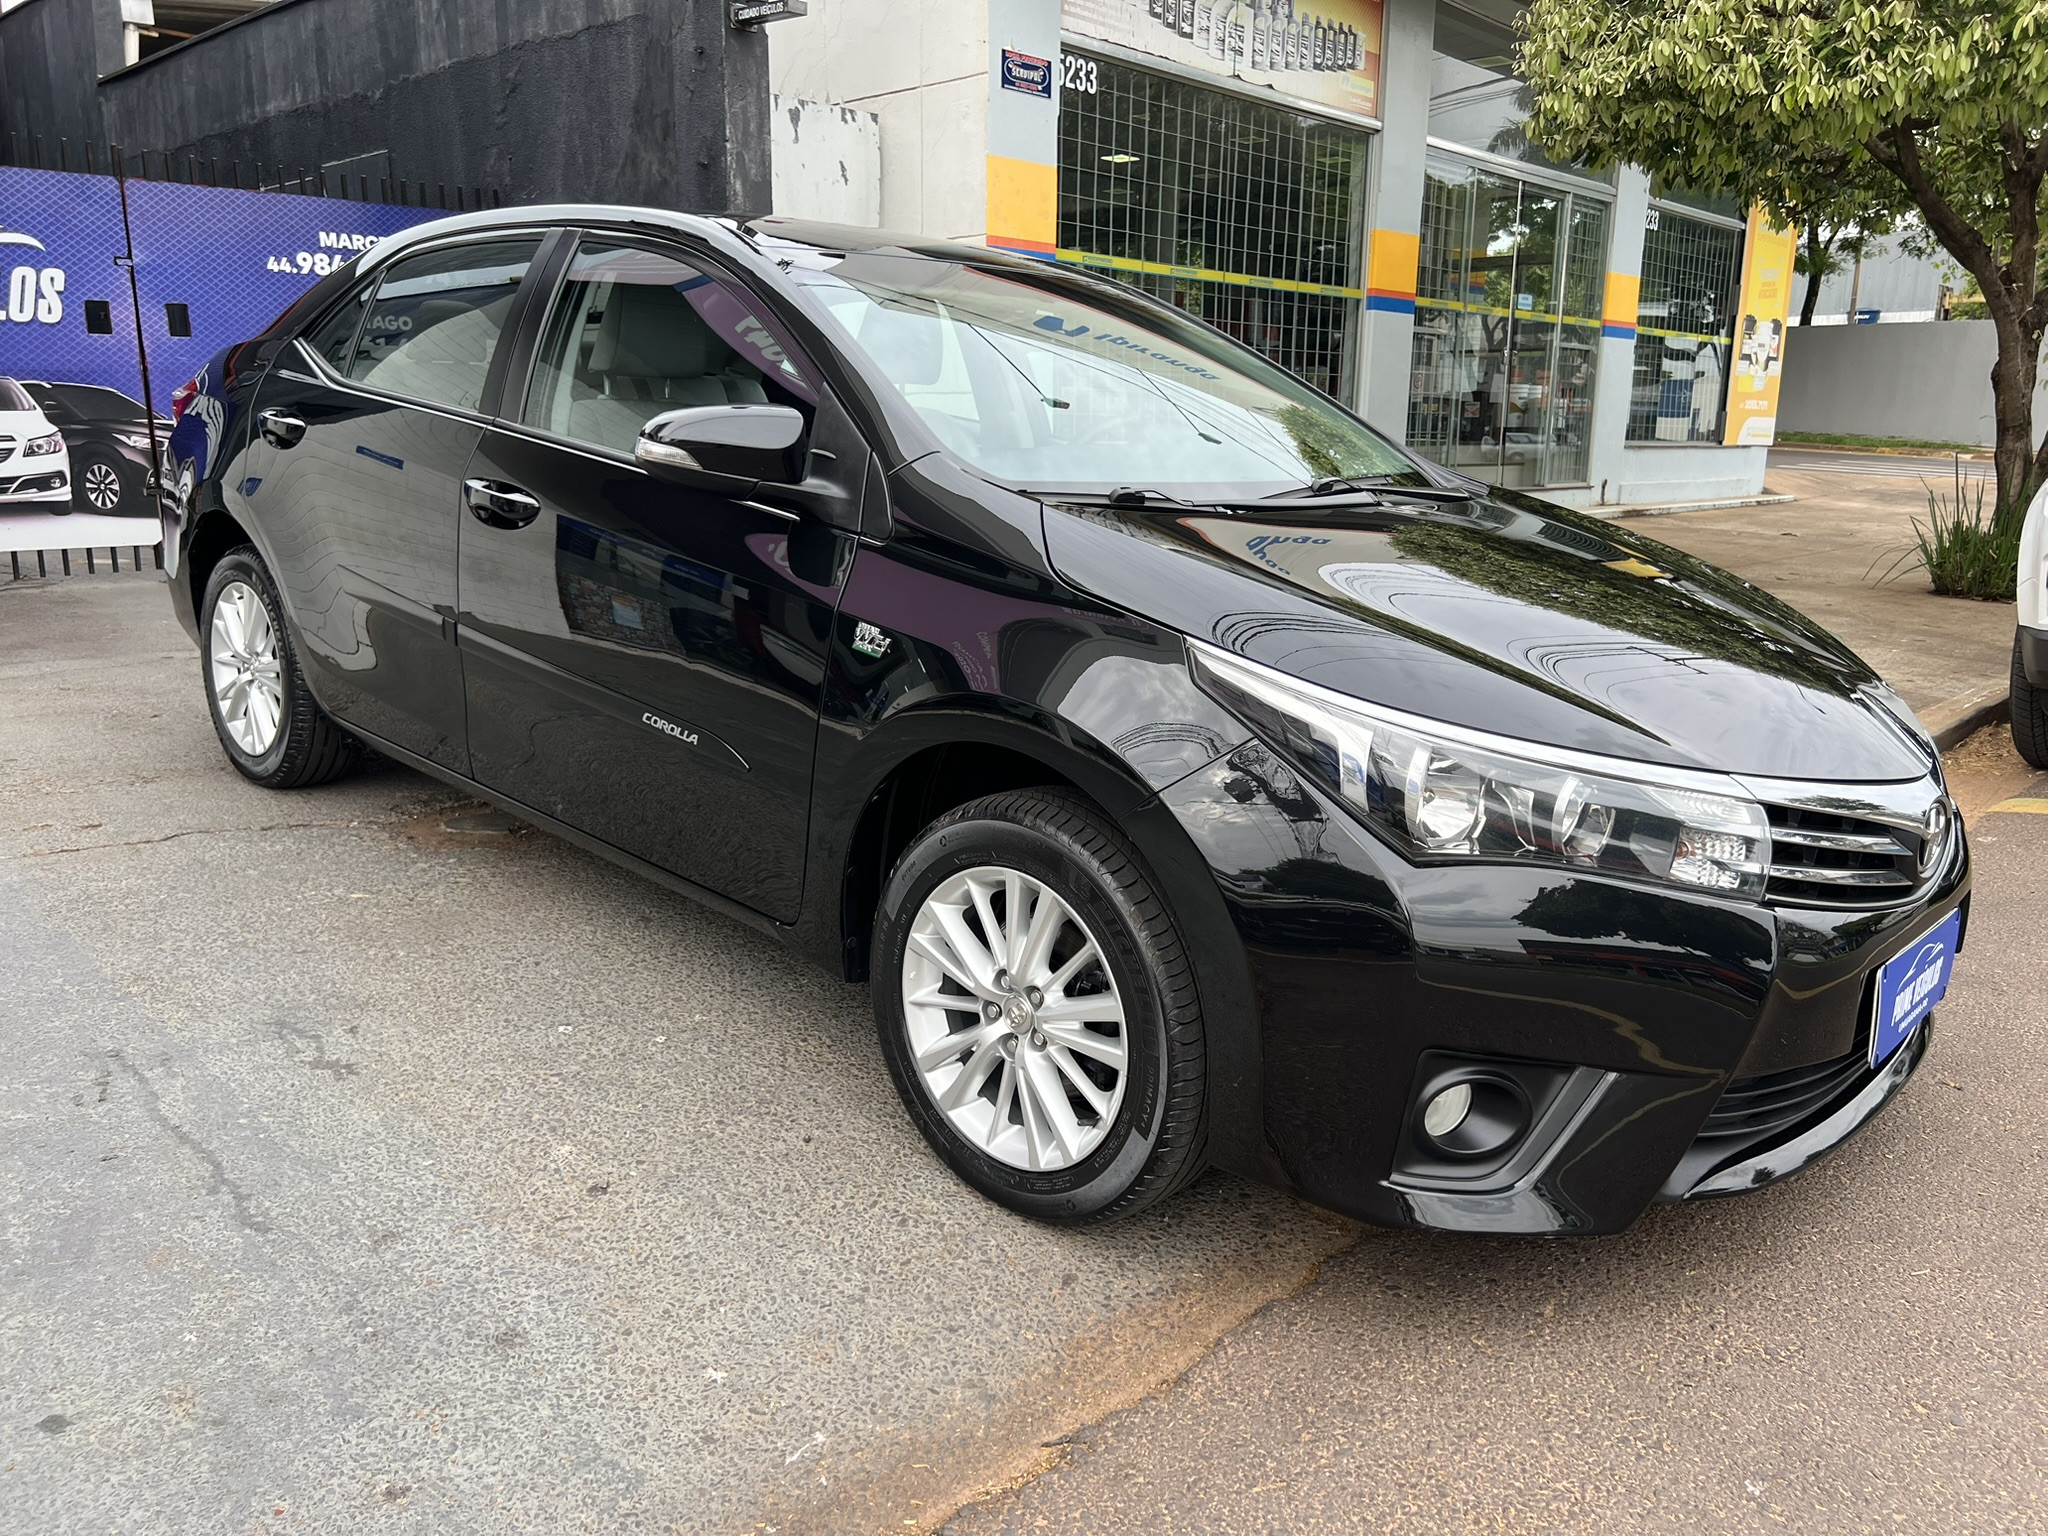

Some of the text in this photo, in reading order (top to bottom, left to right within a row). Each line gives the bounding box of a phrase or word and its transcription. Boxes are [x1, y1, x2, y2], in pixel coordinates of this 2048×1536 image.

[1646, 209, 1659, 231] 233
[319, 231, 386, 251] MARC
[266, 251, 356, 276] 44.984
[0, 266, 65, 323] OS
[642, 712, 698, 745] COROLLA
